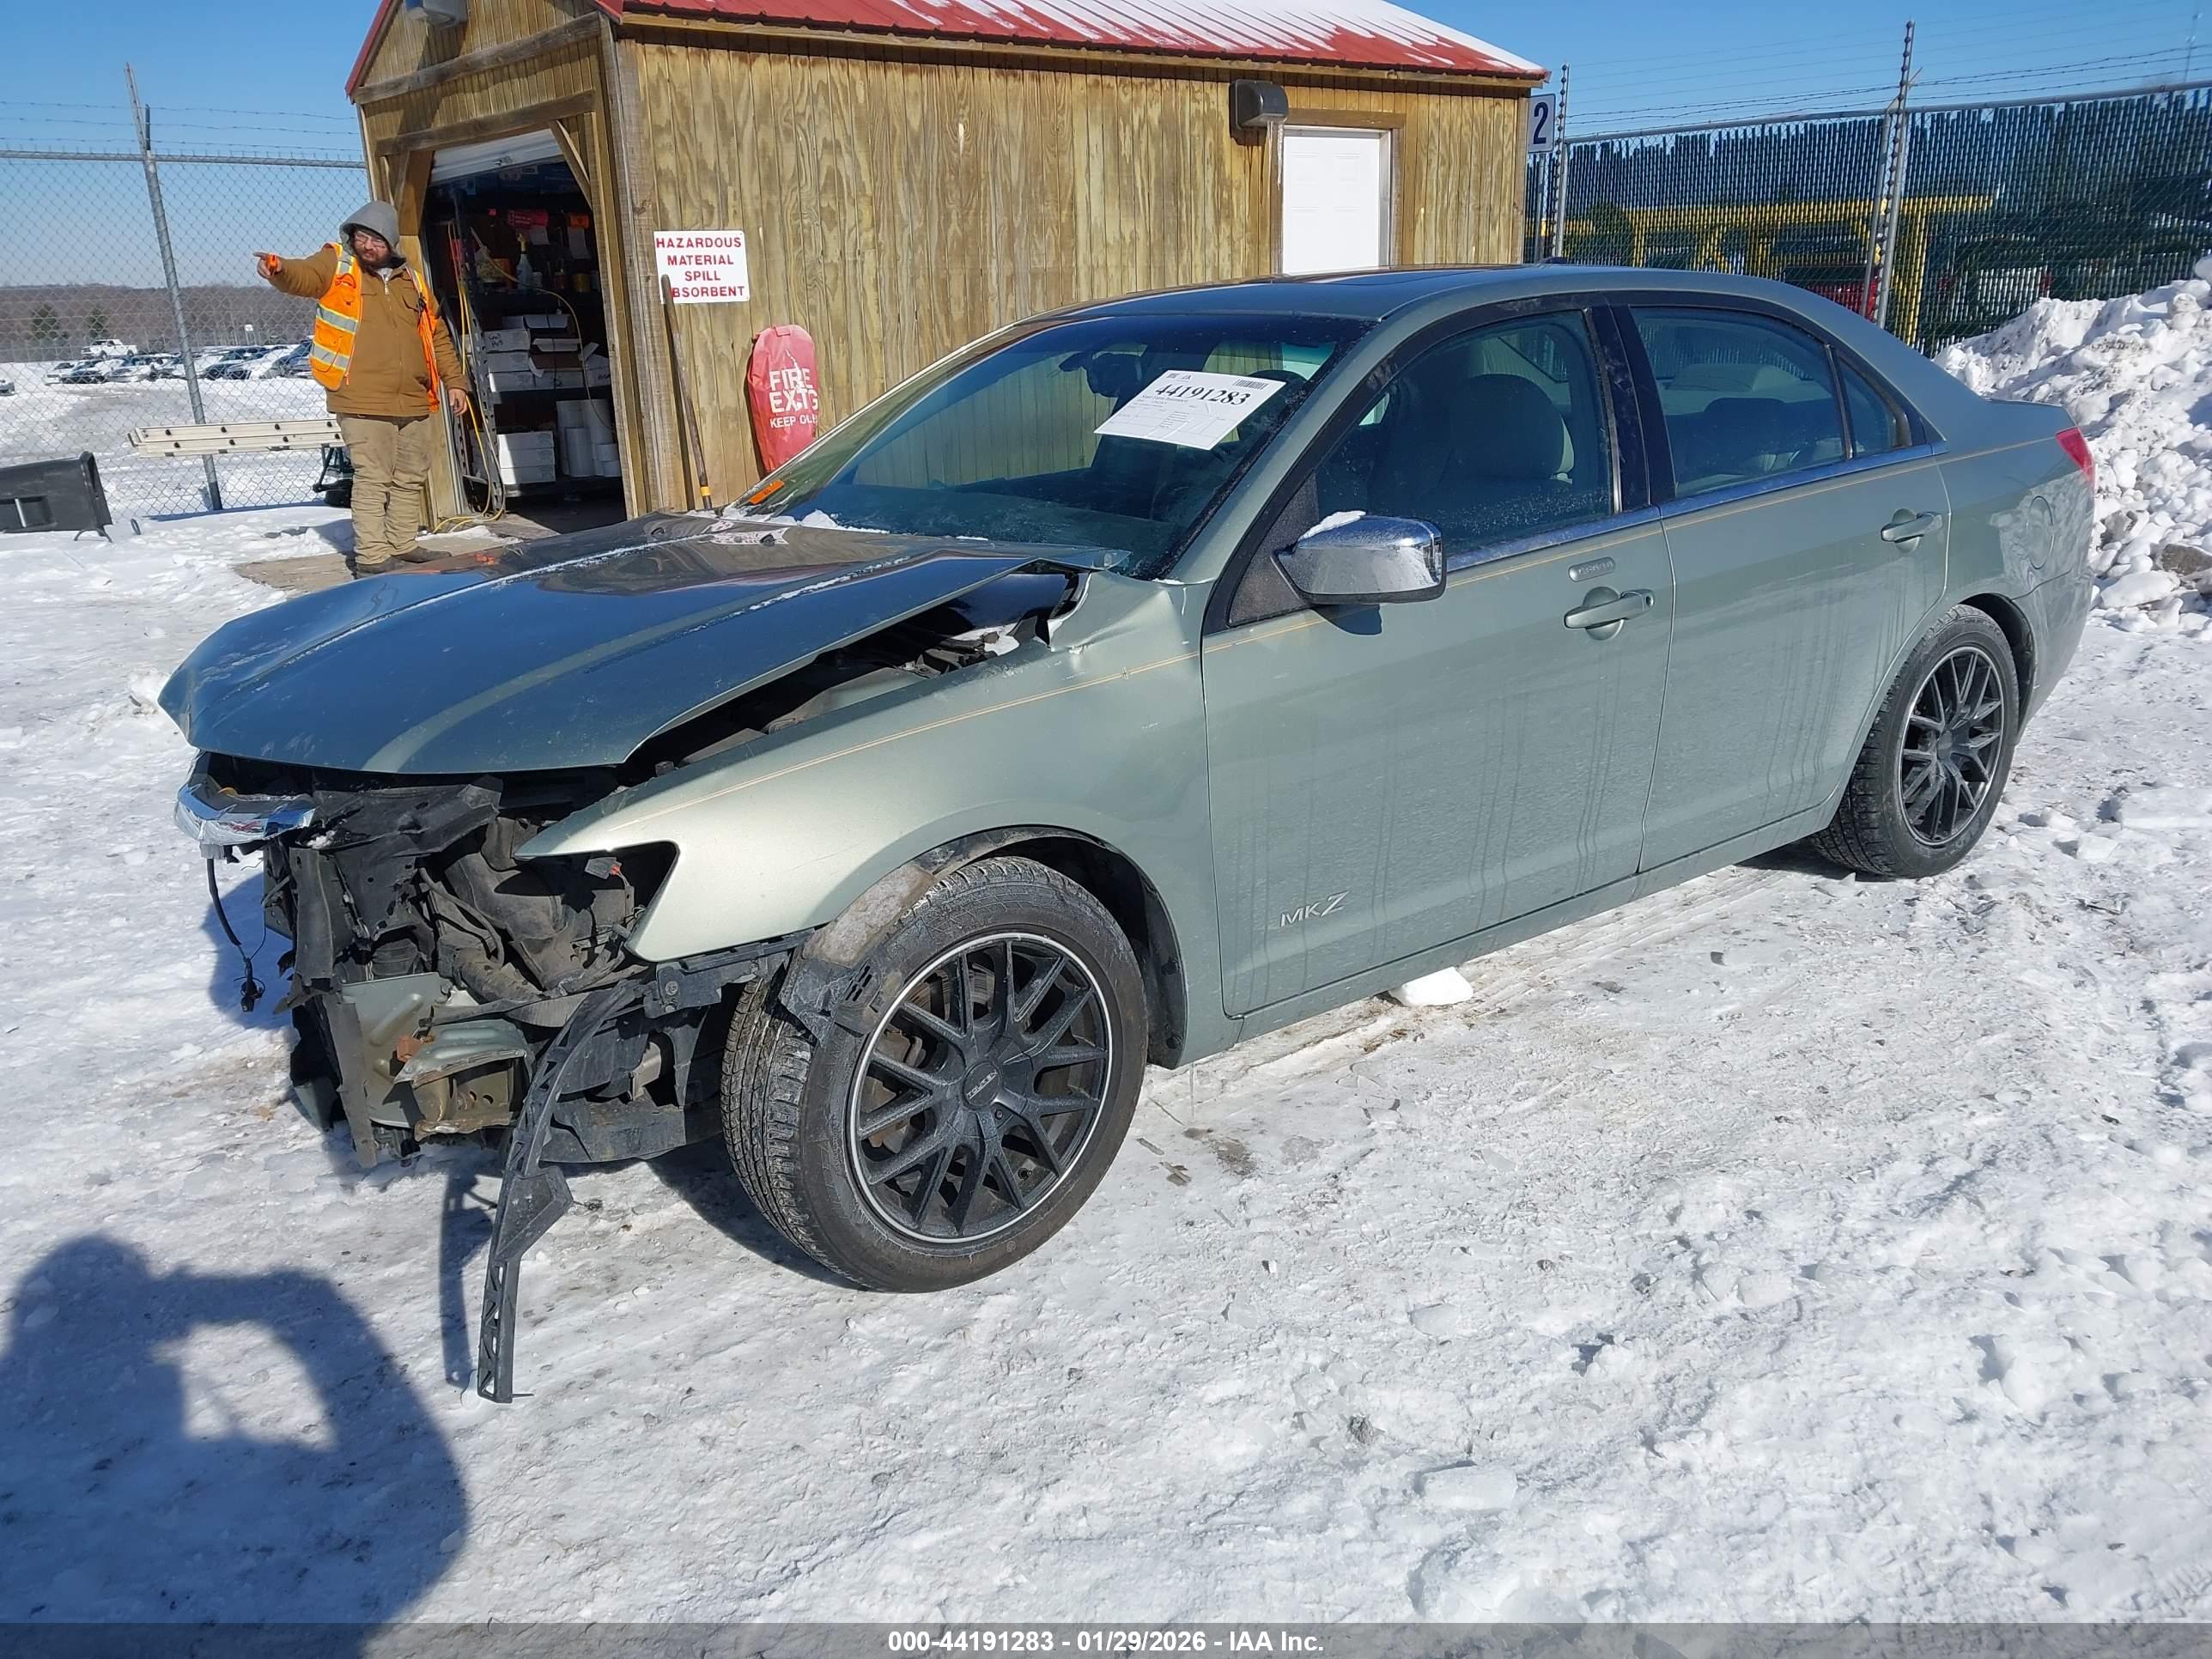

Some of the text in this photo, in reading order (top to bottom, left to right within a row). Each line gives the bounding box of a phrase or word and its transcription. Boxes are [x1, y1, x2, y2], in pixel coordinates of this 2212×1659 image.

[1533, 101, 1549, 144] 2
[656, 237, 742, 248] HAZARDOUS
[667, 254, 734, 265] MATERIAL
[684, 270, 721, 281] SPILL
[672, 286, 744, 298] BSORBENT
[769, 368, 813, 392] FIRE
[1155, 384, 1251, 405] 44191283
[769, 416, 796, 428] KEEP
[1279, 890, 1350, 927] MKZ
